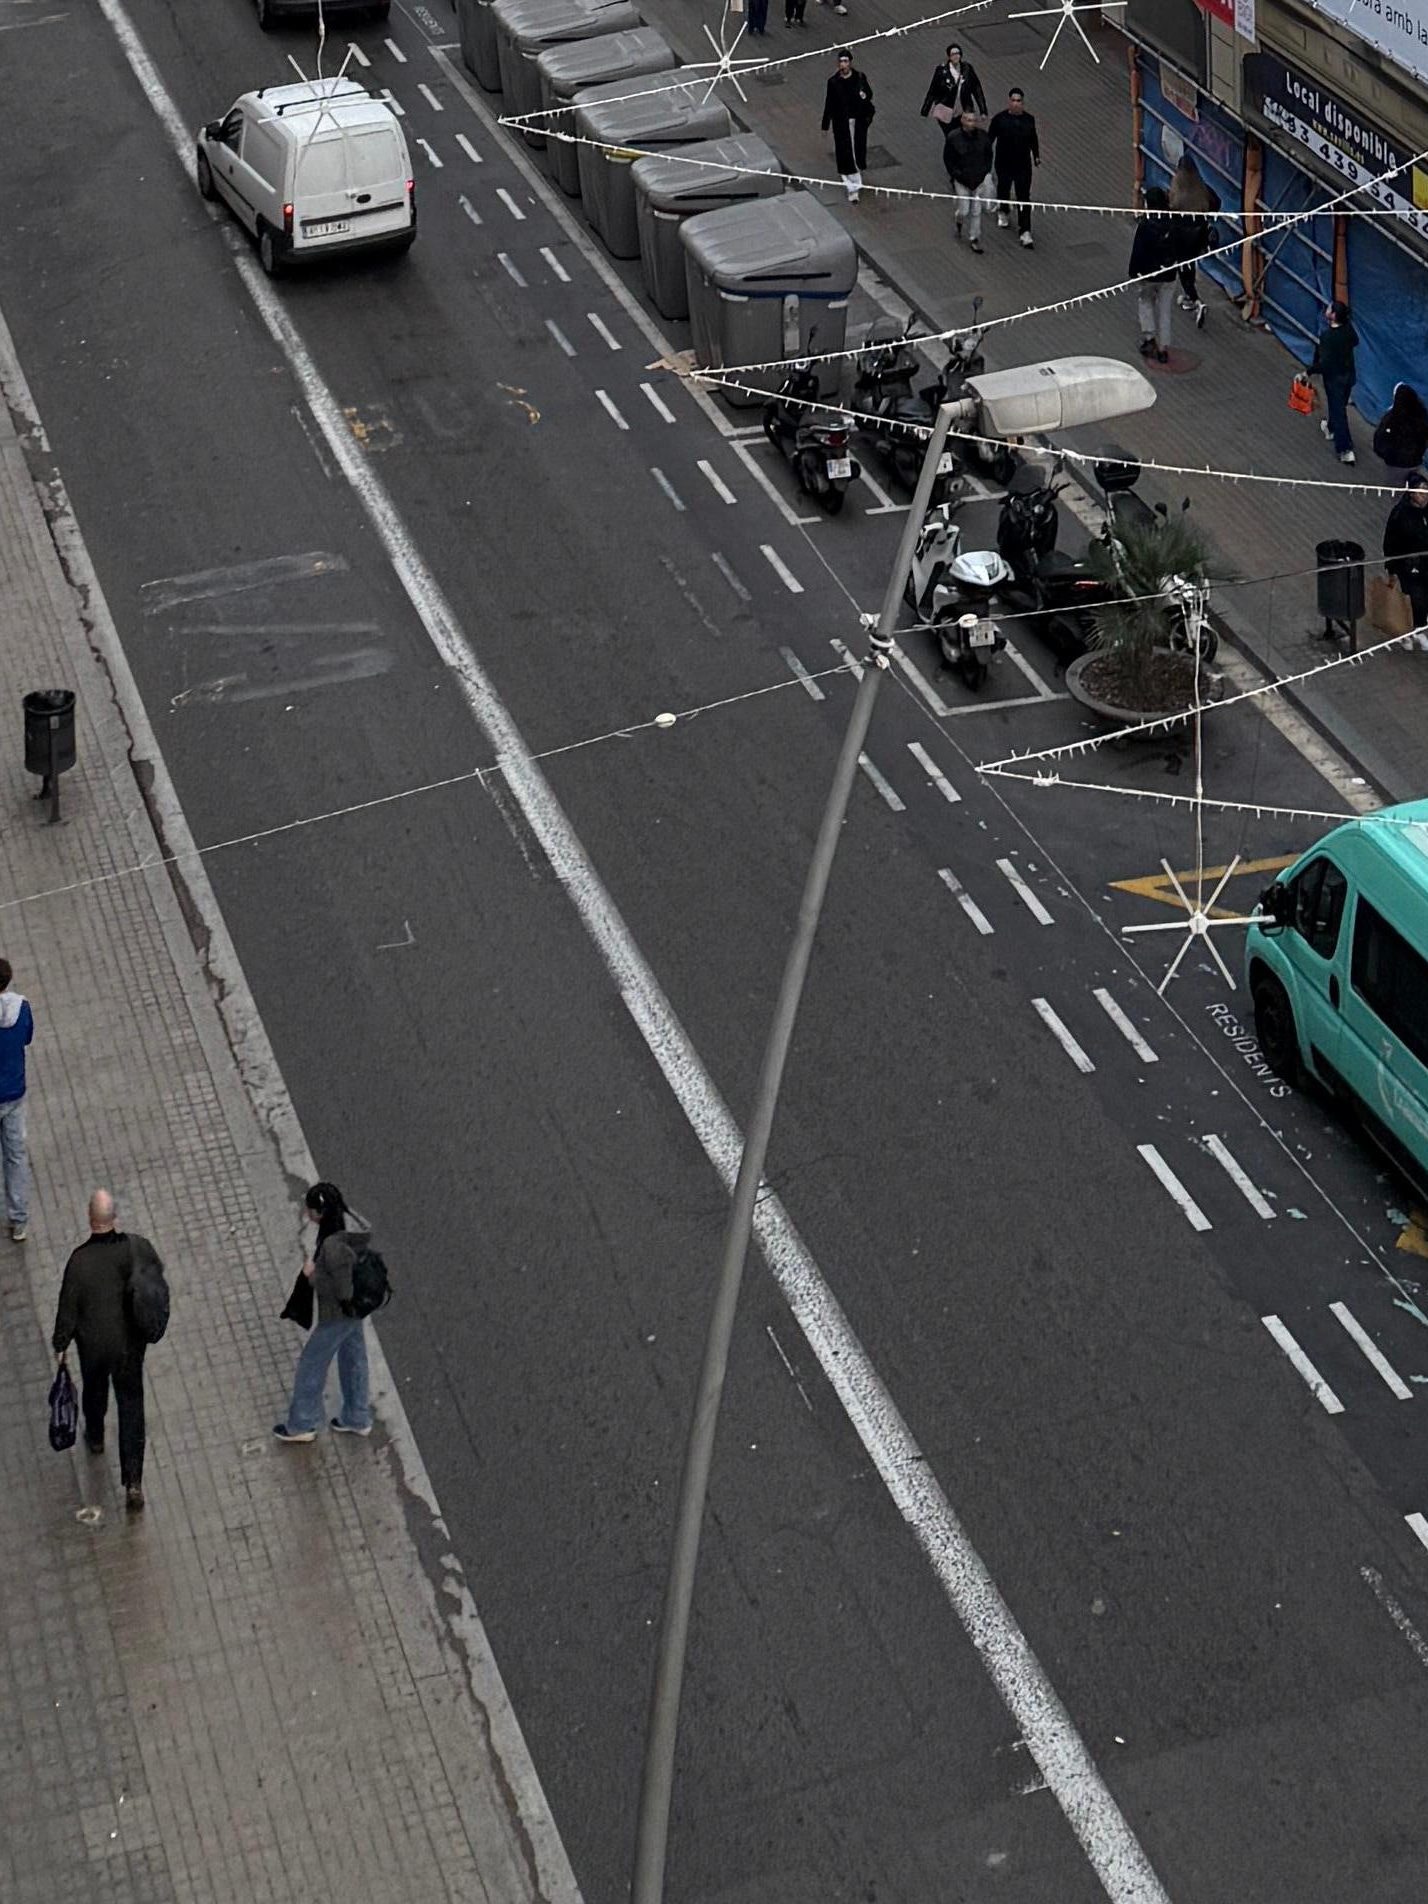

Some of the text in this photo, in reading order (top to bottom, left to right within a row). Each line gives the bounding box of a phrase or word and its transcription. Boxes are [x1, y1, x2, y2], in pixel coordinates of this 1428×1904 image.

[1385, 4, 1414, 36] amb
[1417, 19, 1428, 46] la
[1286, 71, 1320, 115] Local
[1324, 99, 1398, 171] disponible
[1319, 143, 1358, 180] 439
[1204, 1002, 1293, 1099] RESIDENTS
